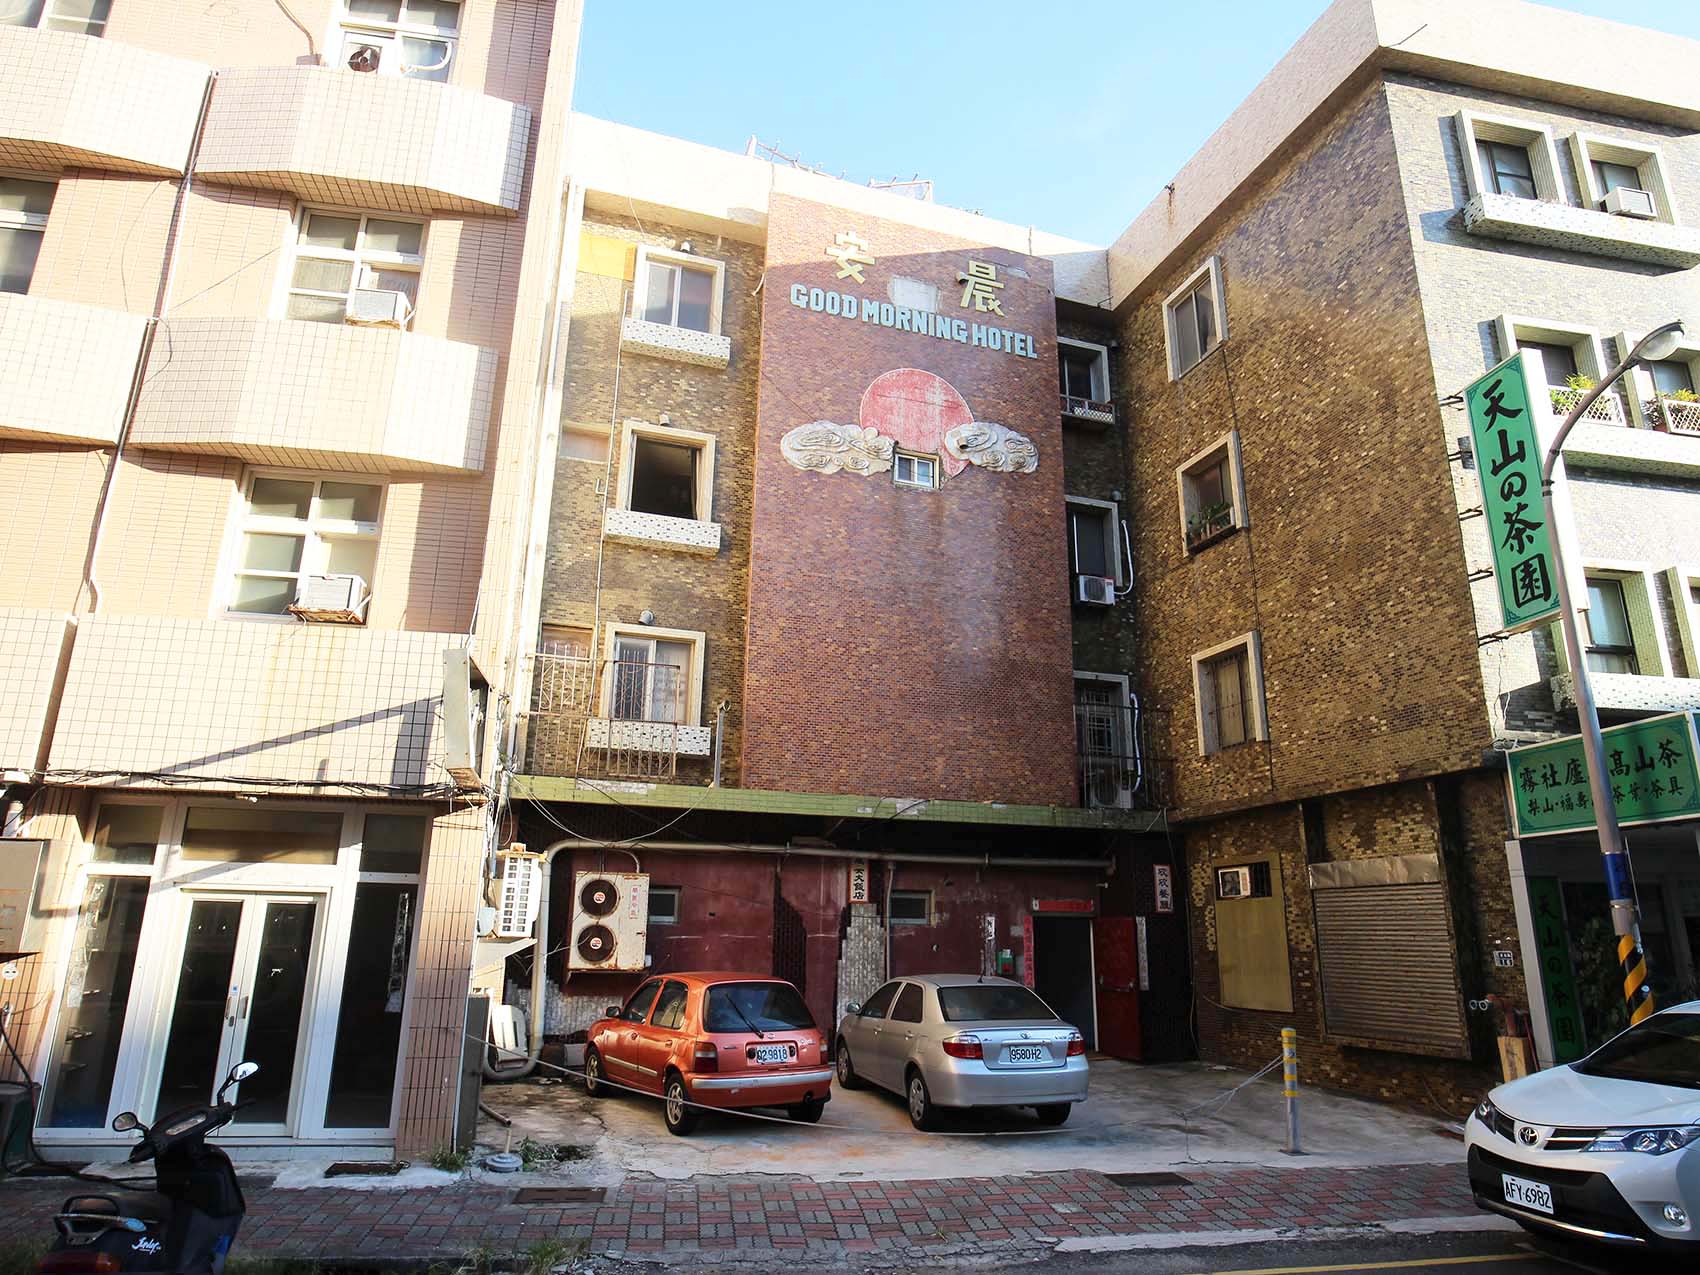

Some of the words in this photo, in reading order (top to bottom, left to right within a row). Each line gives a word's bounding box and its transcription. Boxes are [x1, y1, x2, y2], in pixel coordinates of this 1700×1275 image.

[826, 231, 876, 285] 安
[956, 259, 1005, 317] 晨
[790, 283, 858, 320] GOOD
[860, 301, 968, 344] MORNING
[972, 323, 1038, 359] HOTEL
[1482, 379, 1552, 608] 天山の茶園
